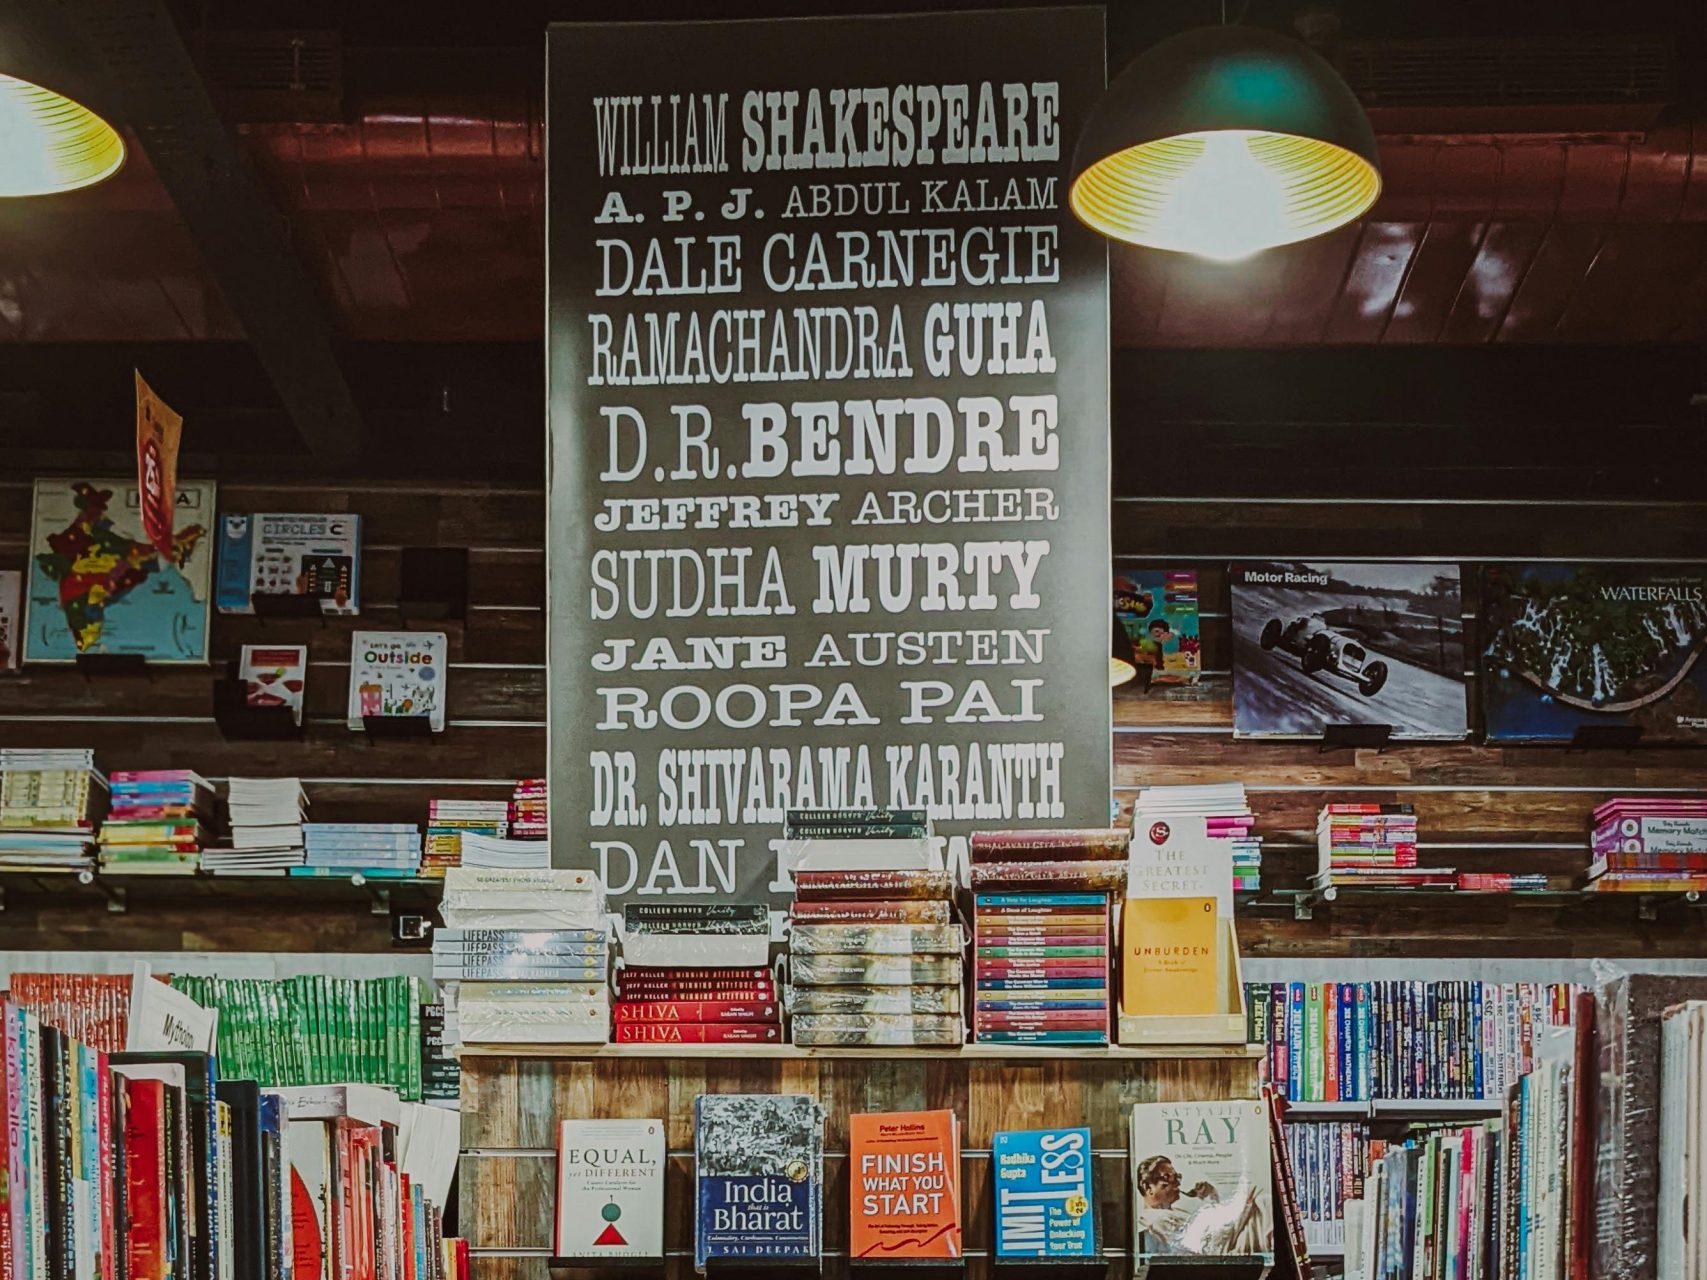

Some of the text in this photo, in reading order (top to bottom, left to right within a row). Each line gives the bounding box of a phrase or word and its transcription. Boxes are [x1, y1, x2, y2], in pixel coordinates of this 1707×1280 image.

[594, 81, 1060, 177] WILLIAM SHAKESPEARE
[594, 177, 1059, 224] A. P. J. ABDUL KALAM
[596, 225, 1060, 298] DALE CARNEGIE
[587, 300, 1057, 387] RAMACHANDRA GUHA
[594, 488, 1060, 533] JEFFREY ARCHER
[262, 523, 327, 536] CIRCLES
[590, 540, 1051, 621] SUDHA MURTY
[1244, 571, 1329, 587] Motor Racing
[1600, 586, 1703, 601] WATERFALLS
[364, 651, 433, 665] Outside
[591, 629, 1051, 672] JANE AUSTEN
[595, 678, 1045, 731] ROOPA PAI
[589, 741, 1064, 828] DR. SHIVARAMA KARANTH
[1648, 826, 1682, 836] Memory
[590, 838, 746, 896] DAN
[1134, 850, 1209, 891] THE GREATEST SECRET
[462, 954, 505, 967] LIFEPASS
[1134, 946, 1209, 957] UNBURDEN
[620, 1004, 679, 1020] SHIVA
[879, 1123, 925, 1133] Peter Hollins
[1165, 1116, 1241, 1146] RAY
[569, 1148, 657, 1167] EQUAL,
[862, 1151, 943, 1175] FINISH
[585, 1168, 657, 1178] DIFFERENT
[863, 1175, 945, 1192] WHAT YOU
[724, 1178, 793, 1203] India
[862, 1192, 944, 1217] START
[714, 1206, 804, 1232] Bharat
